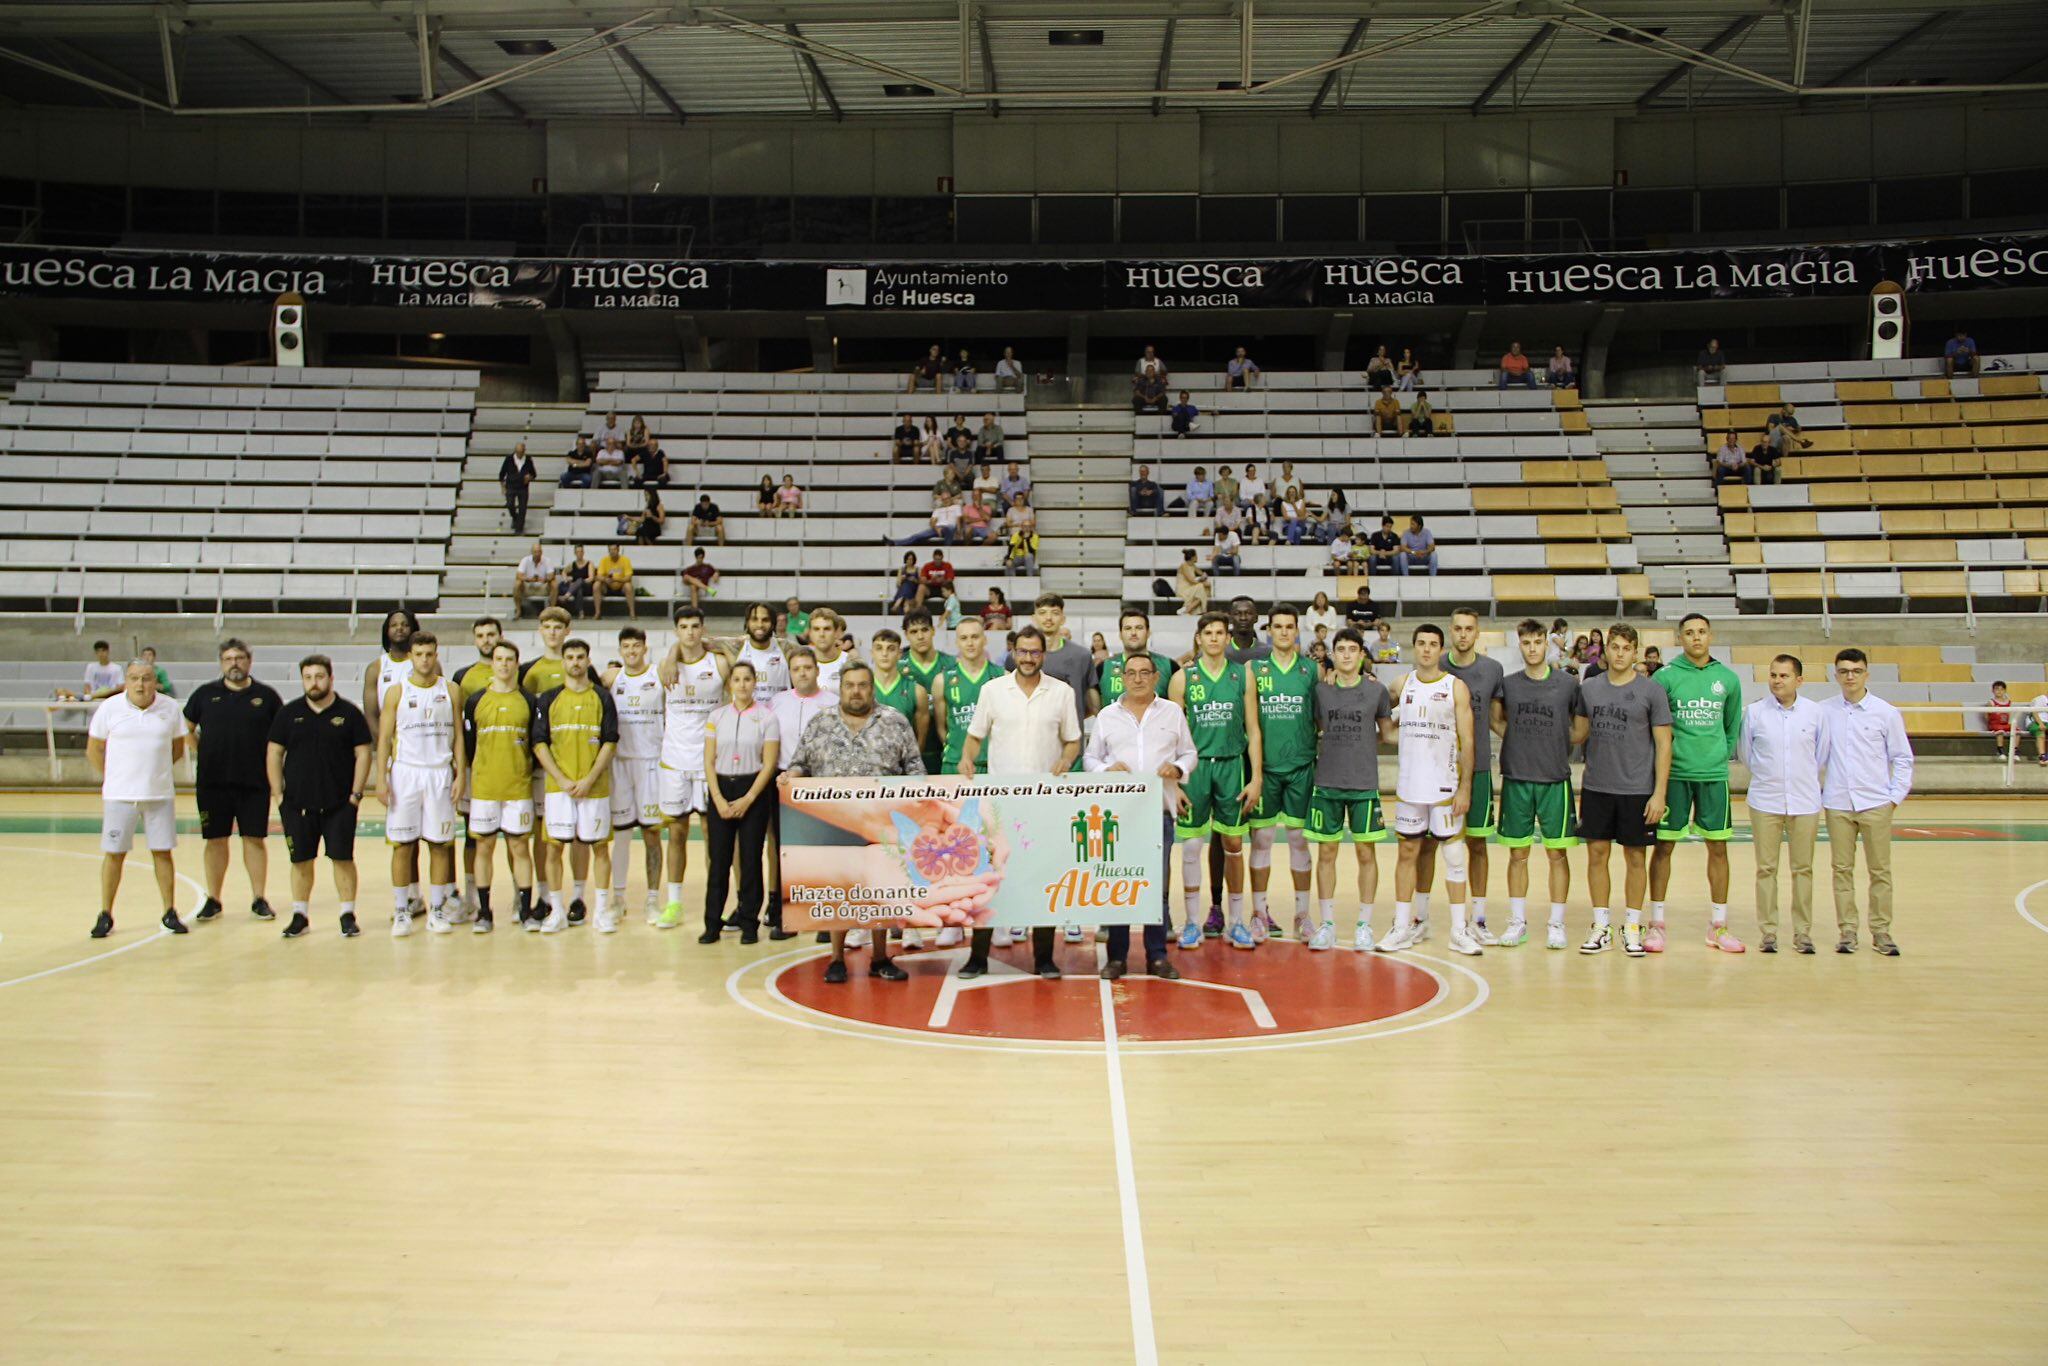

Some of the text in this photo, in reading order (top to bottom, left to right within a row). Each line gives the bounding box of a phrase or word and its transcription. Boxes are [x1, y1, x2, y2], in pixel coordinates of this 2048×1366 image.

[0, 257, 137, 290] uesca
[873, 269, 1009, 289] Ayuntamiento
[873, 290, 975, 306] de Huesca
[1110, 676, 1123, 693] 16
[1257, 676, 1273, 692] 34
[1189, 684, 1205, 702] 33
[793, 783, 1147, 800] Unidos en la lucha, juntos en la esperanza
[519, 812, 530, 825] 10
[1094, 863, 1145, 877] Huesca
[791, 885, 928, 900] Hazte donante
[1044, 868, 1149, 913] Alcer
[811, 902, 913, 921] de órganos
